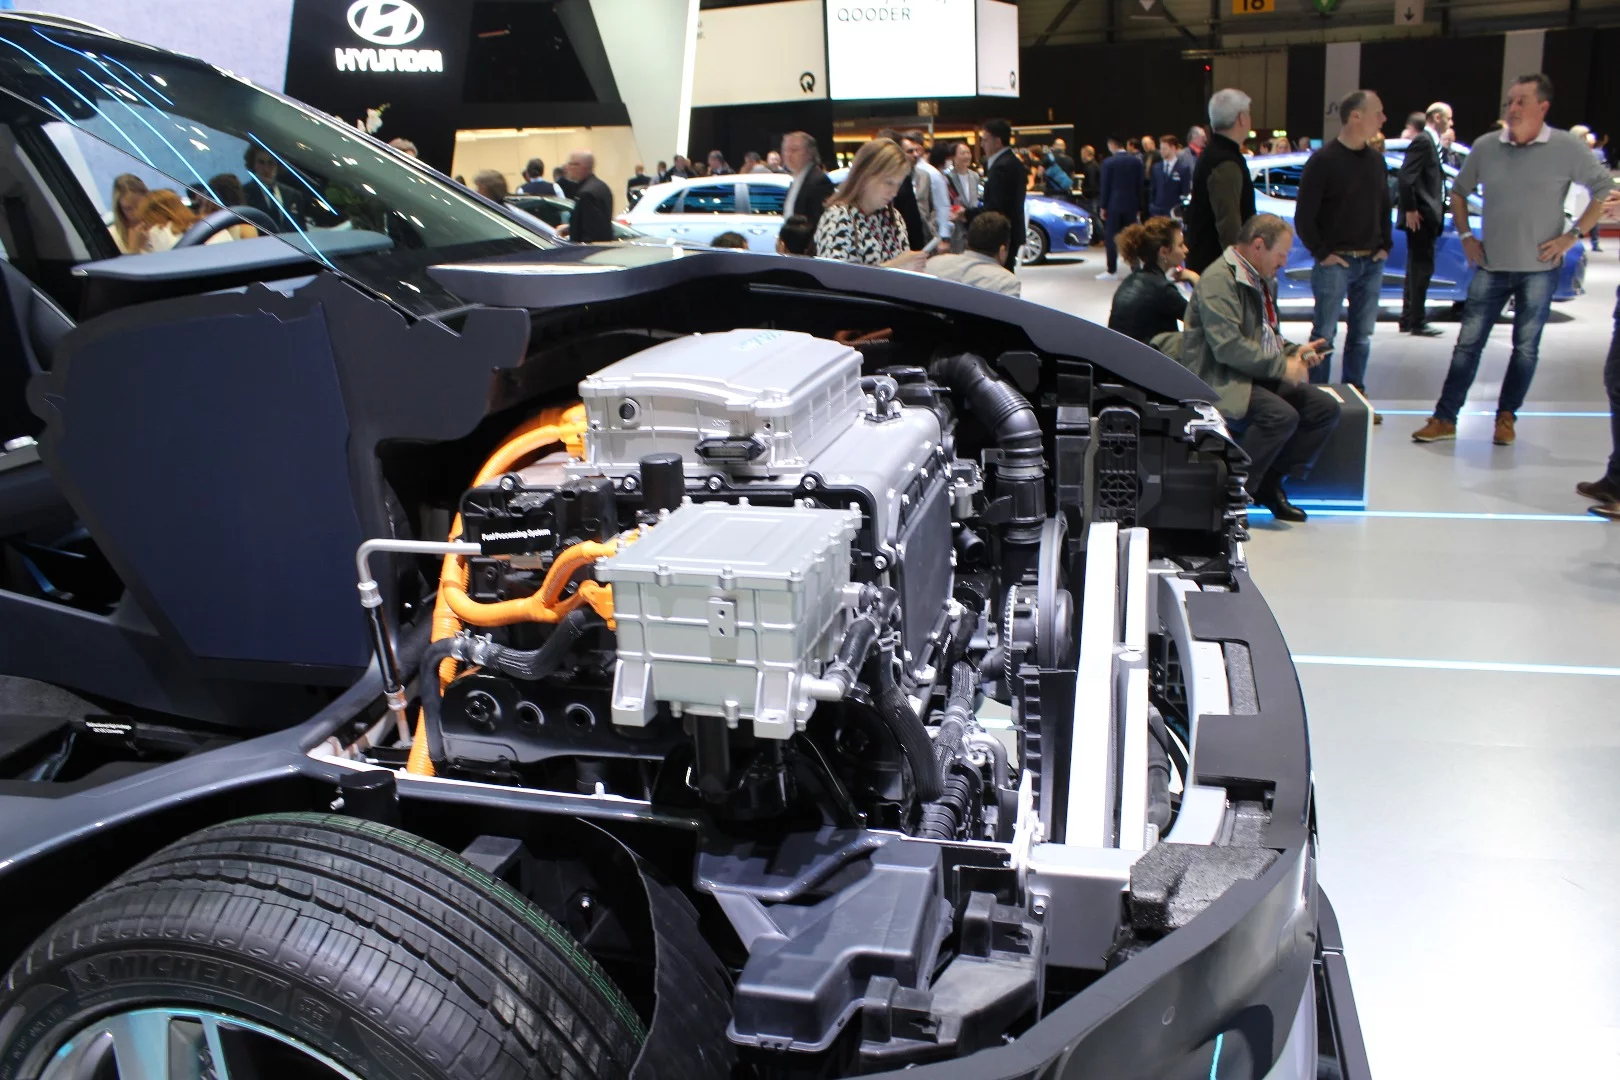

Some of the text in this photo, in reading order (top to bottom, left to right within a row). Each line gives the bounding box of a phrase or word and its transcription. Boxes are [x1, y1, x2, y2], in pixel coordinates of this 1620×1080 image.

[838, 7, 911, 21] QOODER
[334, 48, 443, 72] HYUNDAI
[109, 953, 290, 1012] MICHELIN
